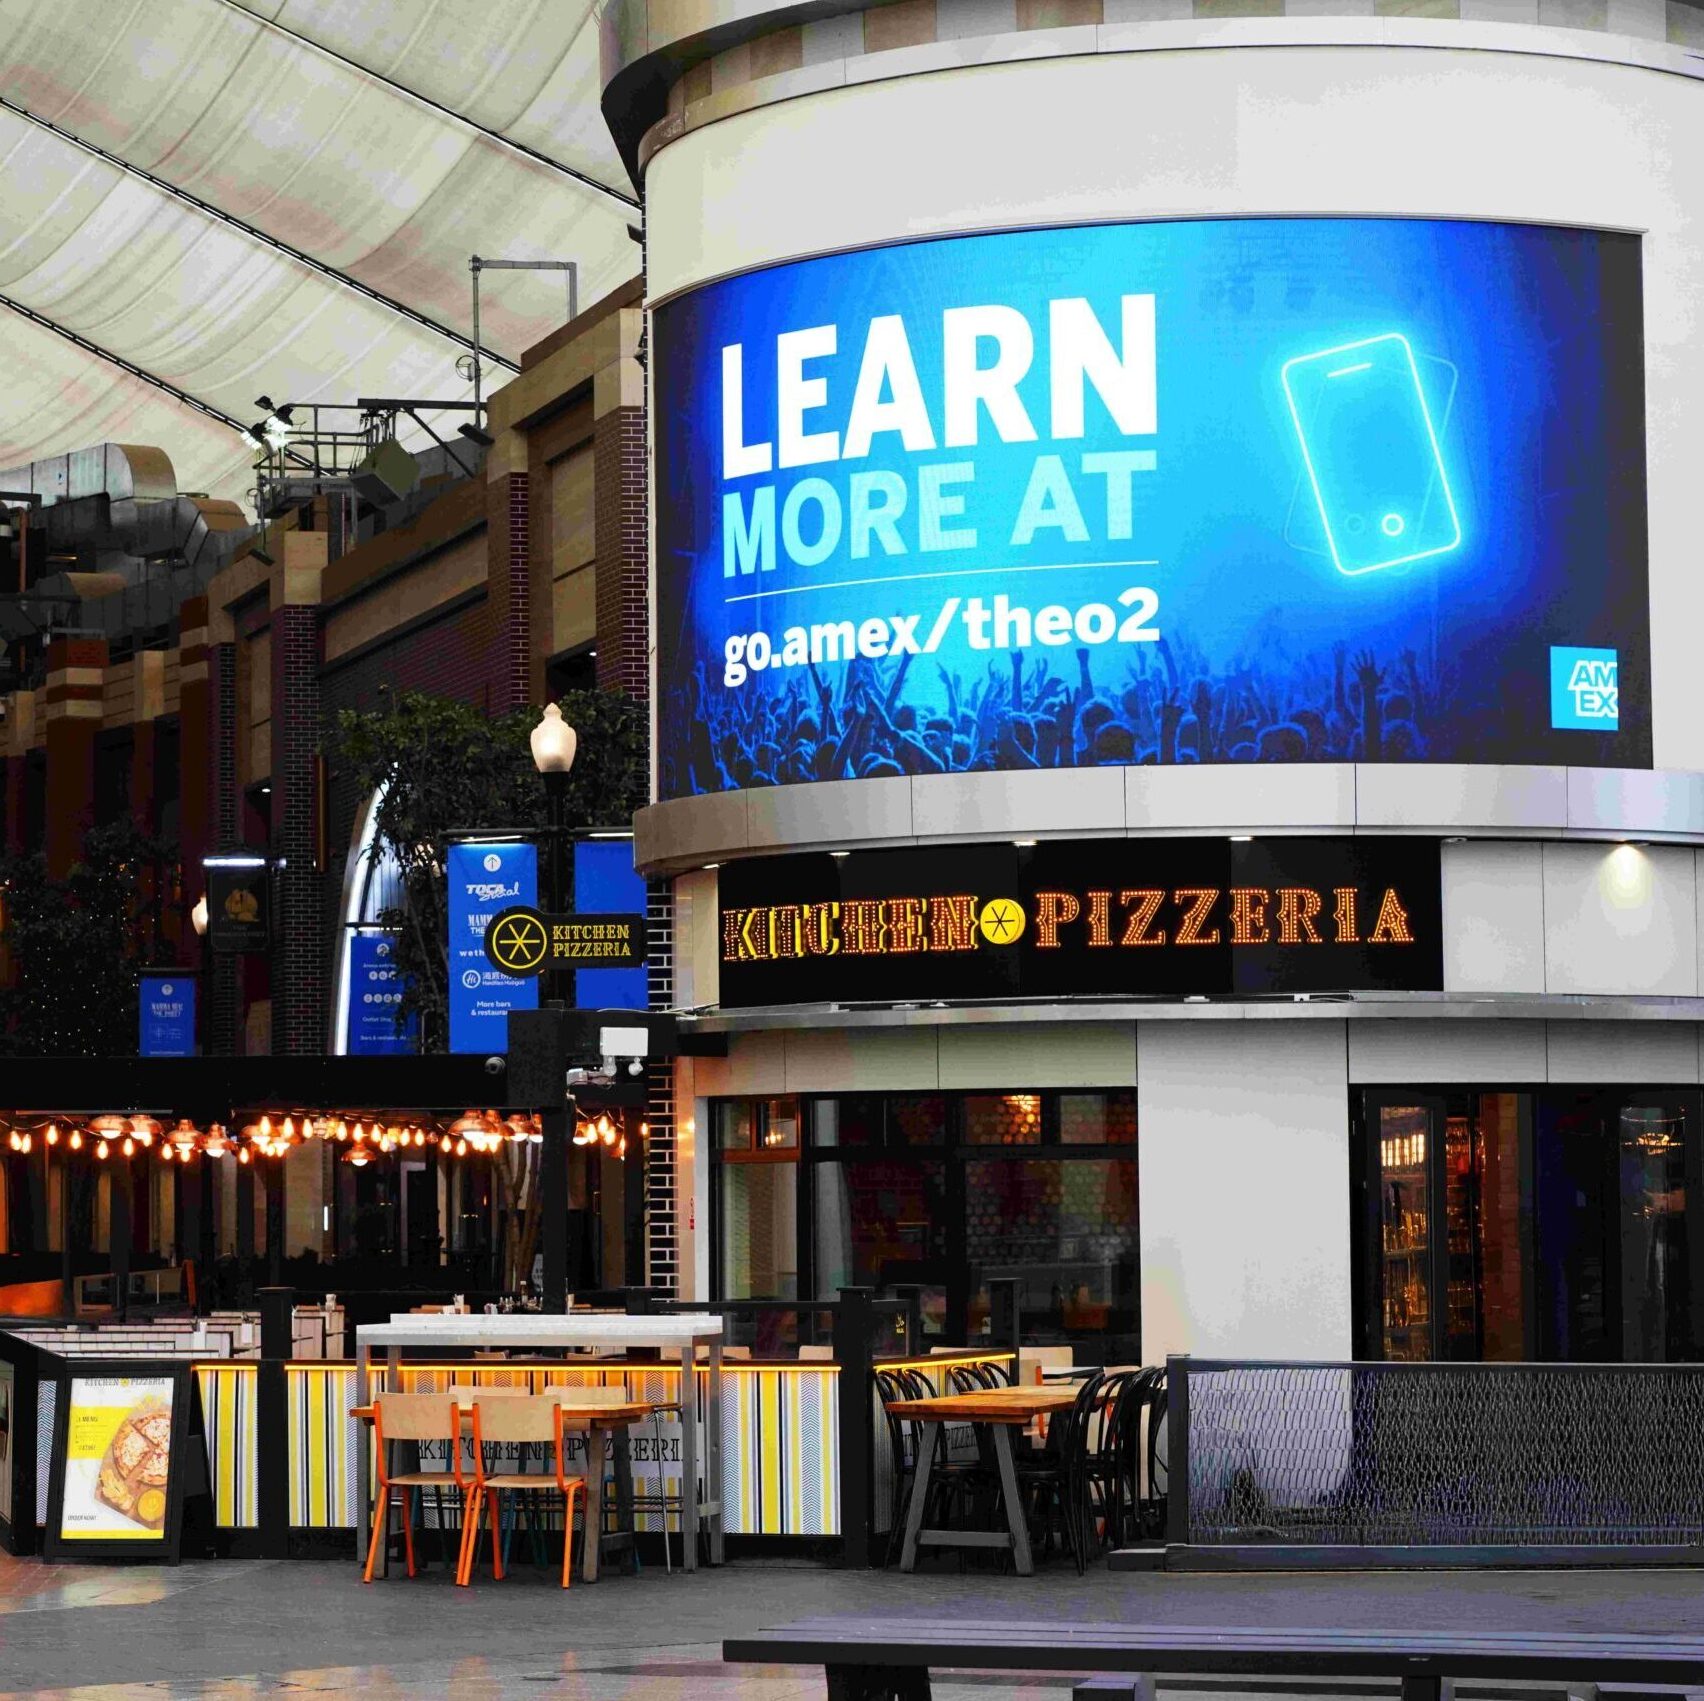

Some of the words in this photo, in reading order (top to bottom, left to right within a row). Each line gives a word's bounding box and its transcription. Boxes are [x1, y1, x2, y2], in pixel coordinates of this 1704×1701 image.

[722, 294, 1157, 479] LEARN
[723, 461, 977, 577] MORE
[1010, 450, 1157, 545] AT
[723, 587, 1160, 687] go.amex/theo2
[552, 924, 630, 940] KITCHEN
[553, 942, 632, 957] PIZZERIA
[724, 895, 978, 961] KITCHEN
[1035, 887, 1414, 948] PIZZERIA
